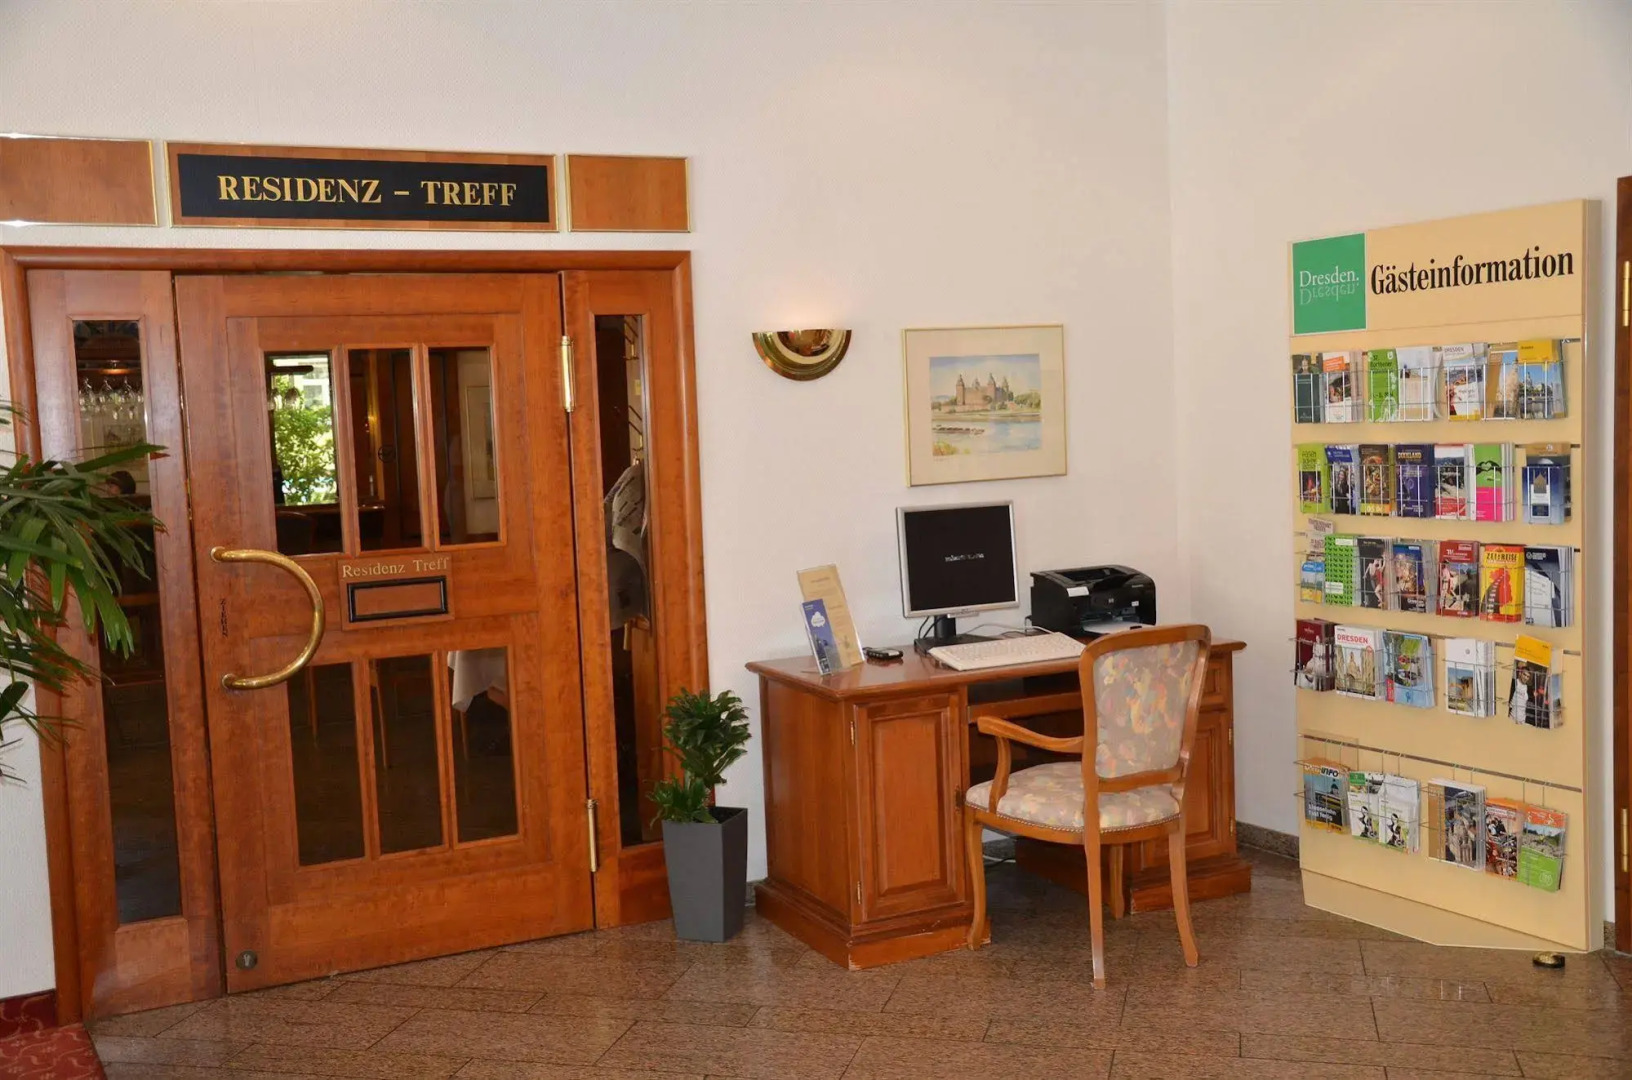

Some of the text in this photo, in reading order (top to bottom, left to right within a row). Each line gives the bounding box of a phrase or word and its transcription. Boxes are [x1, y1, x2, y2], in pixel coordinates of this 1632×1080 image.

[217, 175, 383, 204] RESIDENZ
[421, 181, 518, 206] TREFF
[1299, 265, 1360, 287] Dresden.
[1370, 245, 1574, 296] Gästeinformation
[342, 557, 450, 578] Residenz Treff
[1337, 633, 1369, 645] DRESDEN
